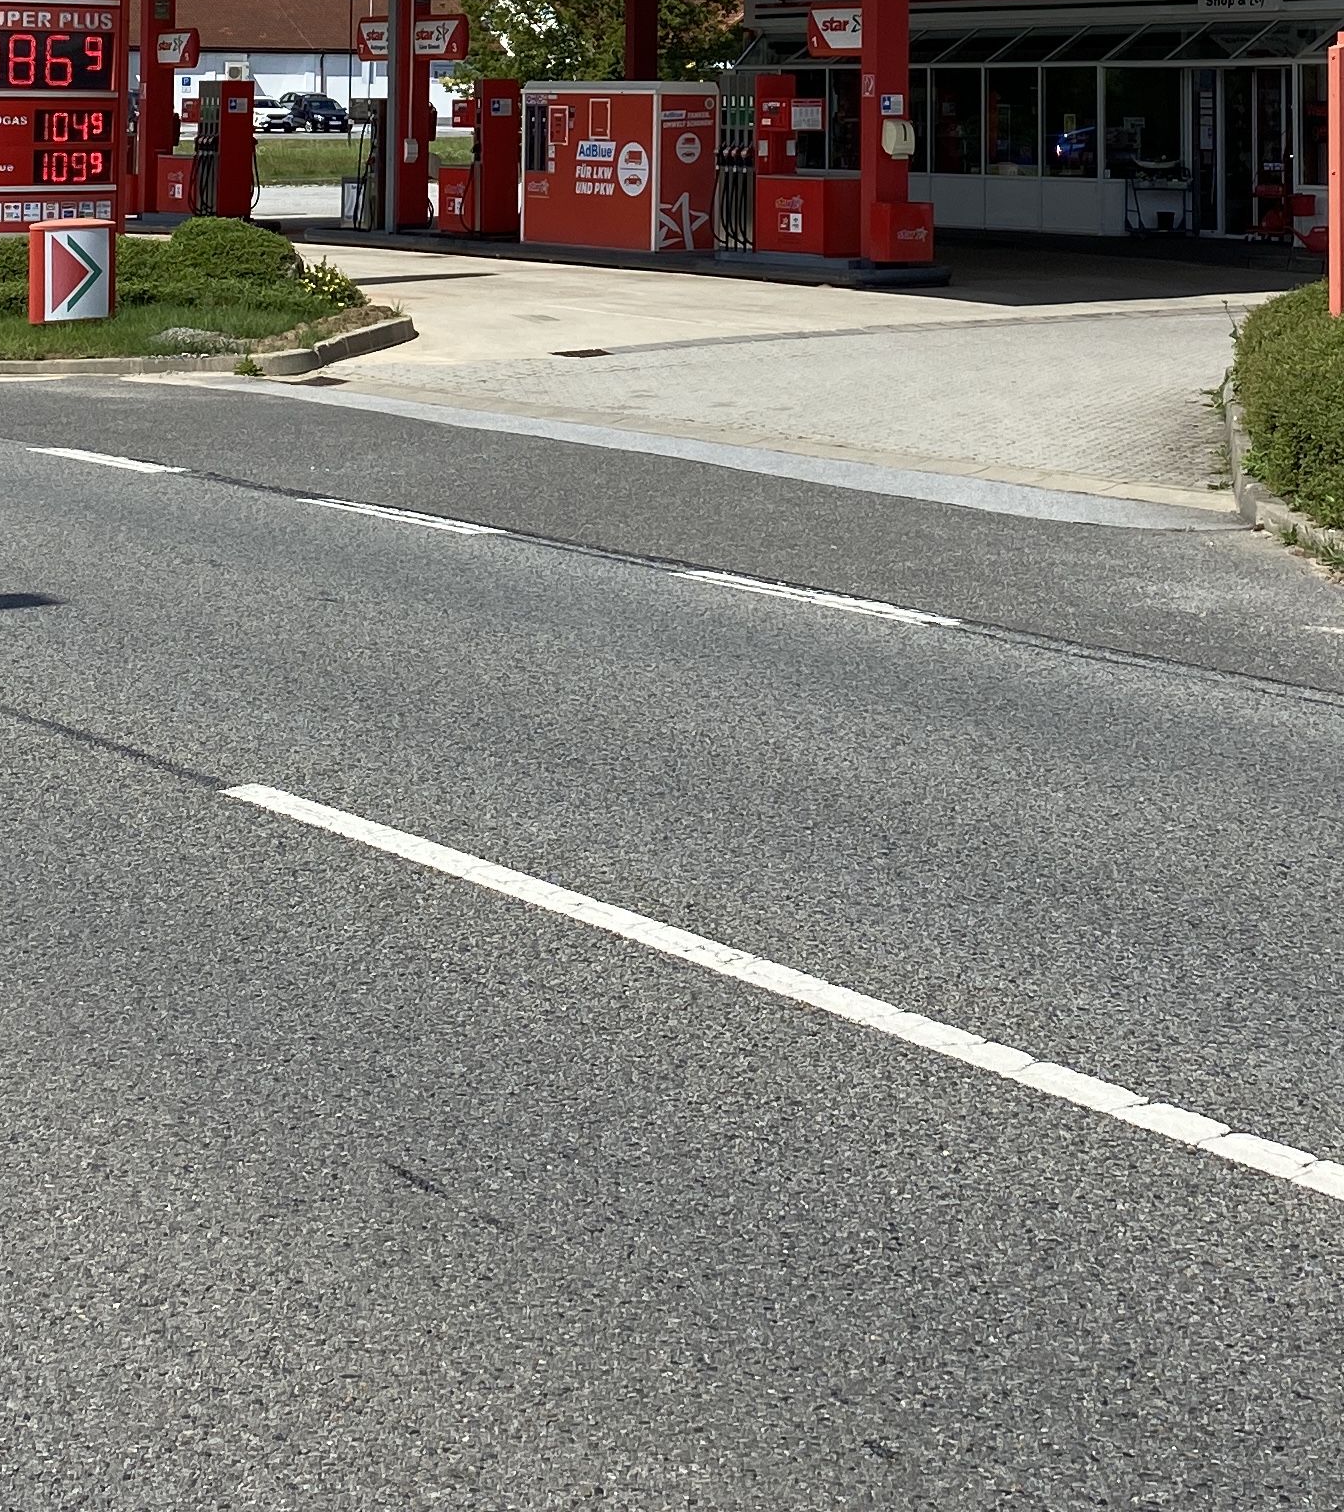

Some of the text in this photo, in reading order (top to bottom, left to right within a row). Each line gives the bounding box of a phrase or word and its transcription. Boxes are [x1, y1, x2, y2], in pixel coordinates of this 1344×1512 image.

[59, 12, 113, 30] PLUS
[822, 17, 849, 32] star
[366, 29, 385, 41] star
[416, 28, 434, 40] star
[43, 111, 103, 142] 1049
[579, 143, 613, 158] AdBlue
[575, 164, 613, 179] FÜR LKW
[575, 182, 615, 195] UND PKW
